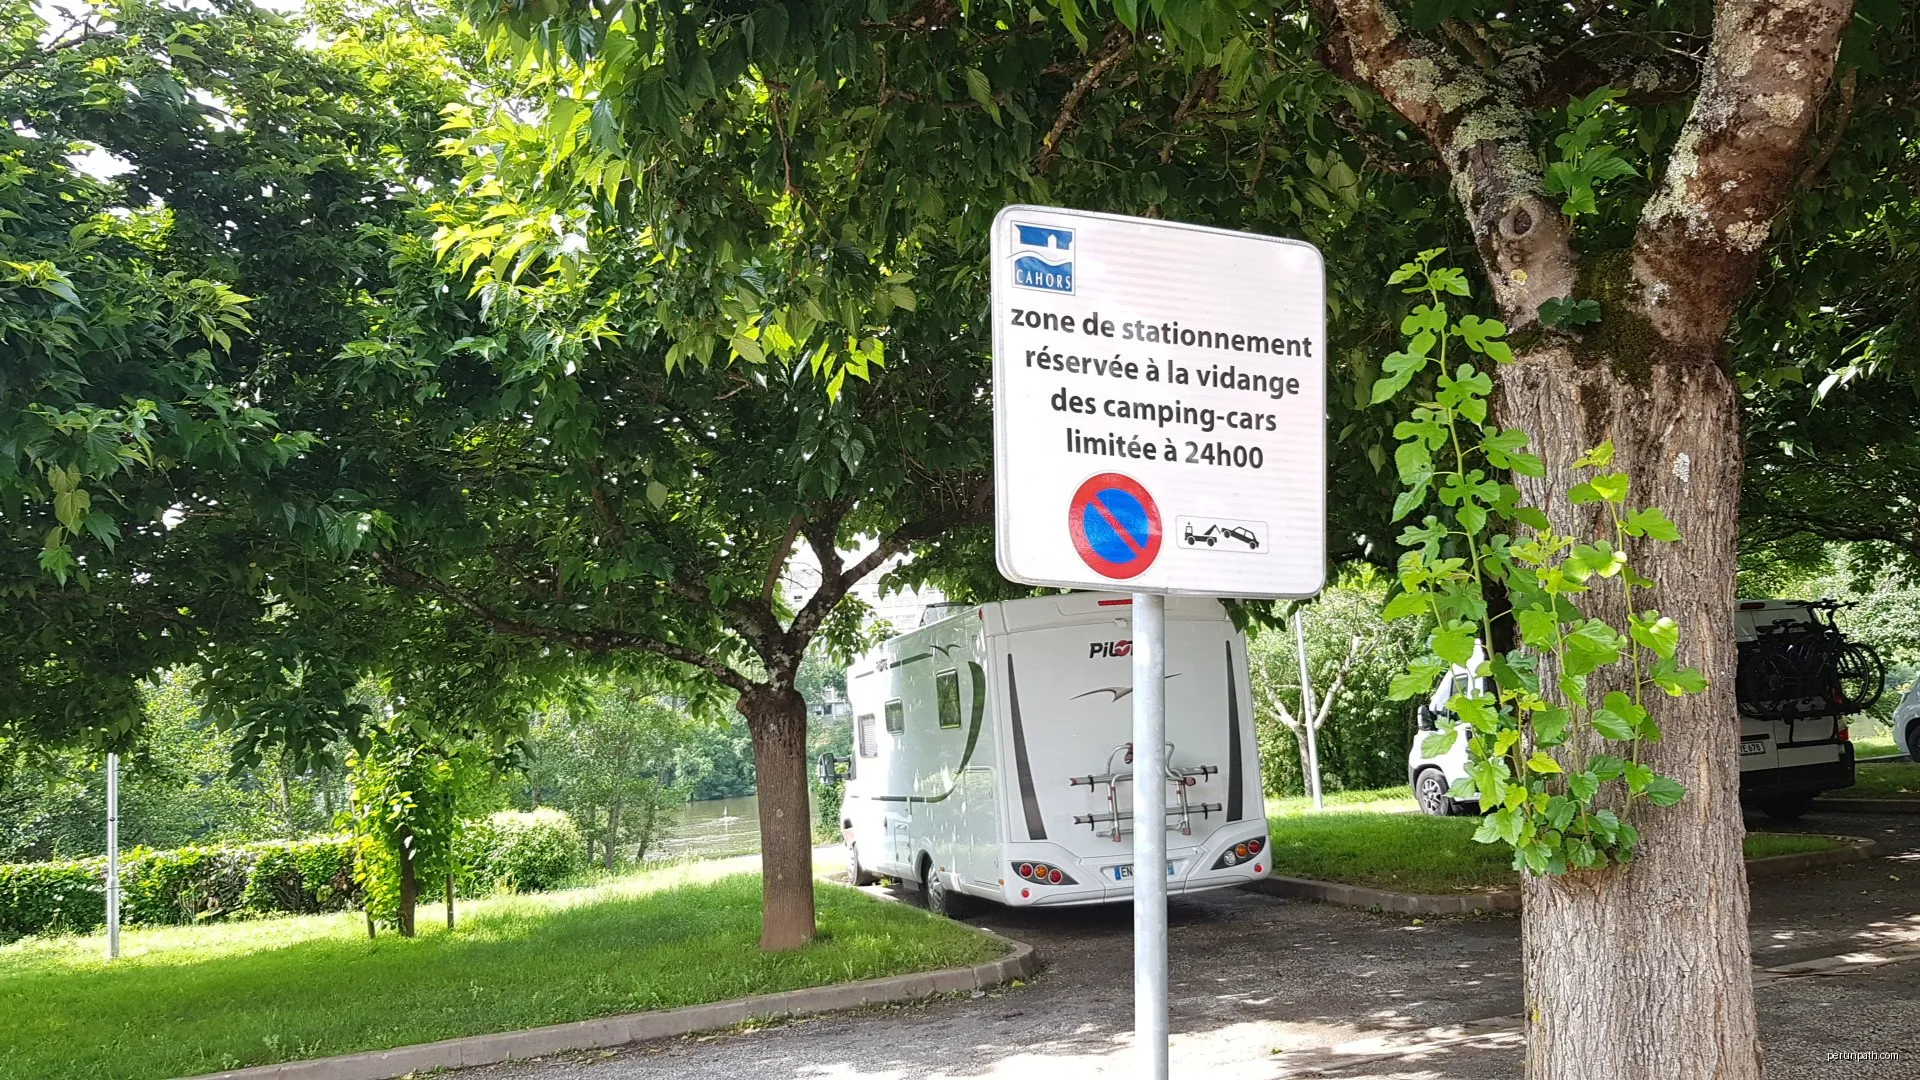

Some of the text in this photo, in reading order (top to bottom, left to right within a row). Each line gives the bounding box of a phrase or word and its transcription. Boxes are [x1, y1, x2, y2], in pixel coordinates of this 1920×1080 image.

[1016, 269, 1071, 290] CAHORS
[1010, 308, 1312, 358] zone de stationnement
[1025, 345, 1300, 400] réservée à la vidange
[1050, 386, 1277, 433] des camping-cars
[1066, 427, 1264, 470] limitée à 24h00
